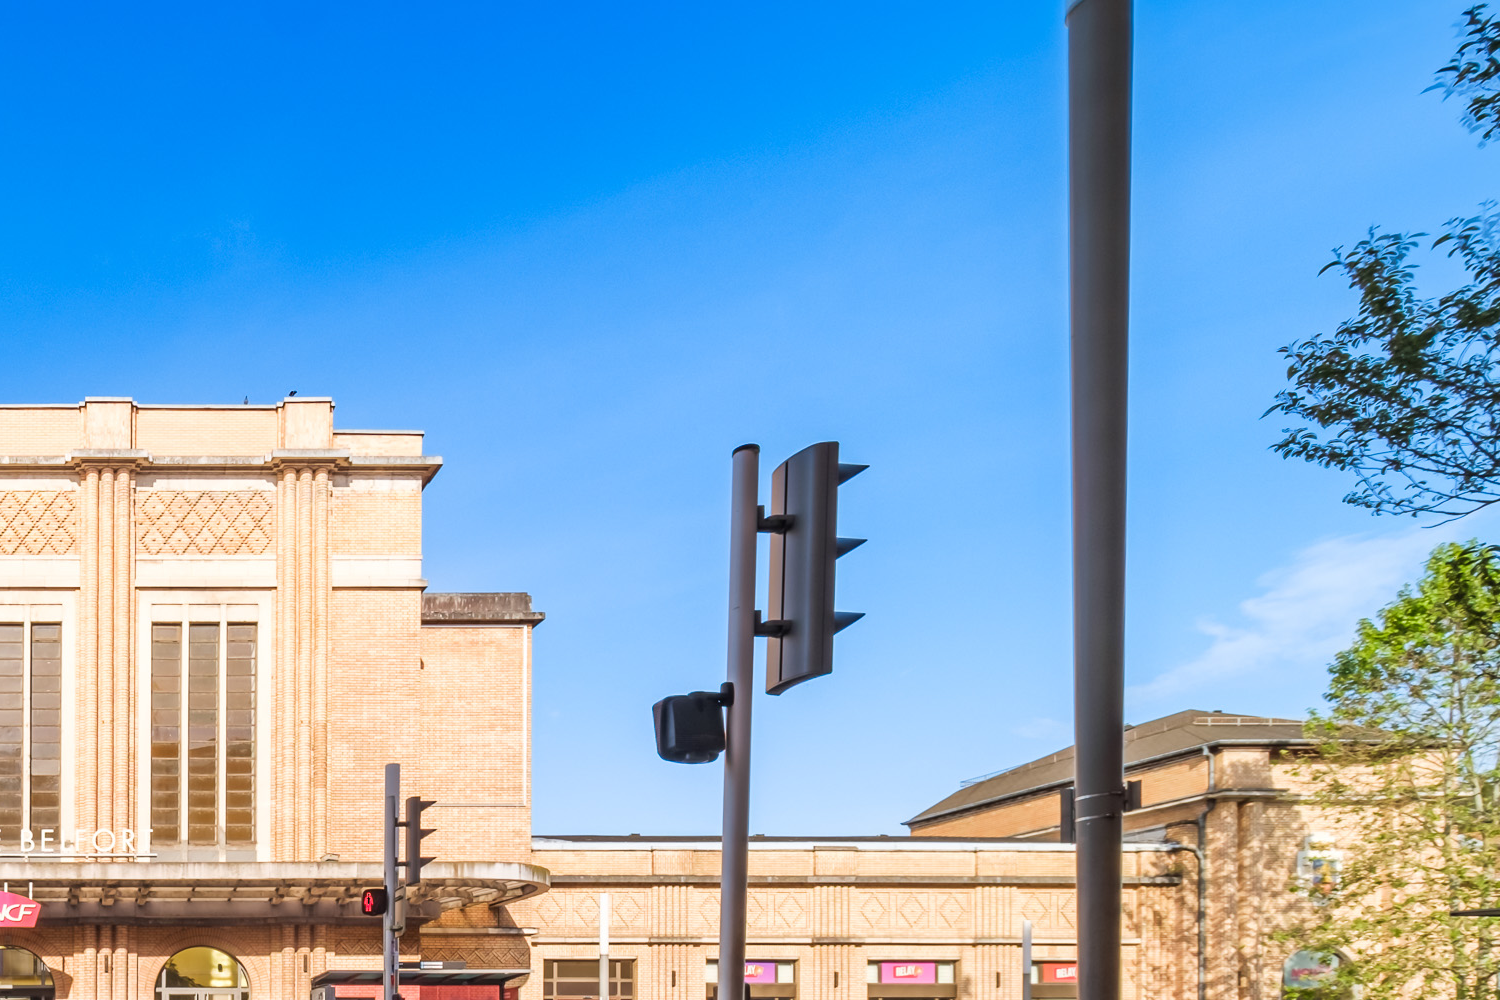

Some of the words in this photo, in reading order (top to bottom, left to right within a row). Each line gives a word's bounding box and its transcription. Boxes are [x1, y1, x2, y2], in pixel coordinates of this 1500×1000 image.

[20, 828, 154, 852] BELFORT
[744, 964, 756, 976] LAY
[895, 965, 916, 977] RELAY
[1056, 967, 1077, 979] RELAY
